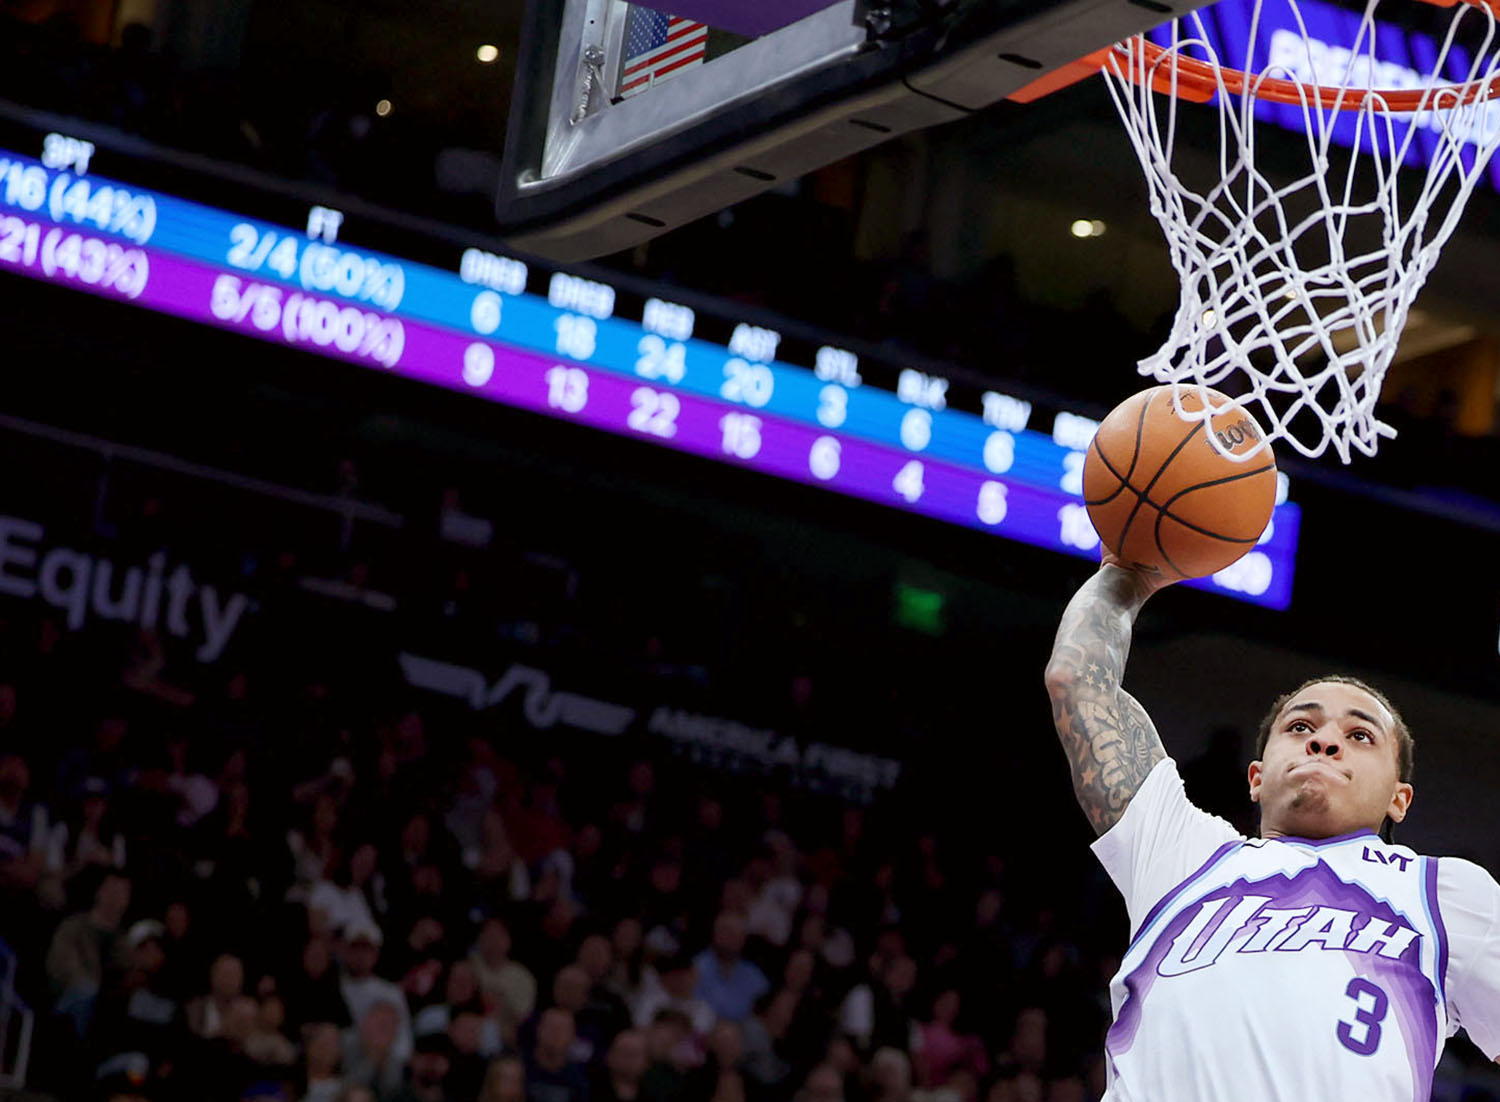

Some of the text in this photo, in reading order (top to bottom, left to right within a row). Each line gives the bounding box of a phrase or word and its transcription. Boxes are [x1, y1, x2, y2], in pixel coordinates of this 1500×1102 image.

[226, 223, 298, 279] 2/4
[635, 334, 687, 384] 24
[720, 357, 774, 408] 20
[816, 384, 848, 428] 3
[627, 386, 680, 438] 22
[892, 459, 925, 504] 4
[0, 513, 249, 664] Equity
[1156, 894, 1424, 978] UTAH
[1336, 976, 1389, 1057] 3
